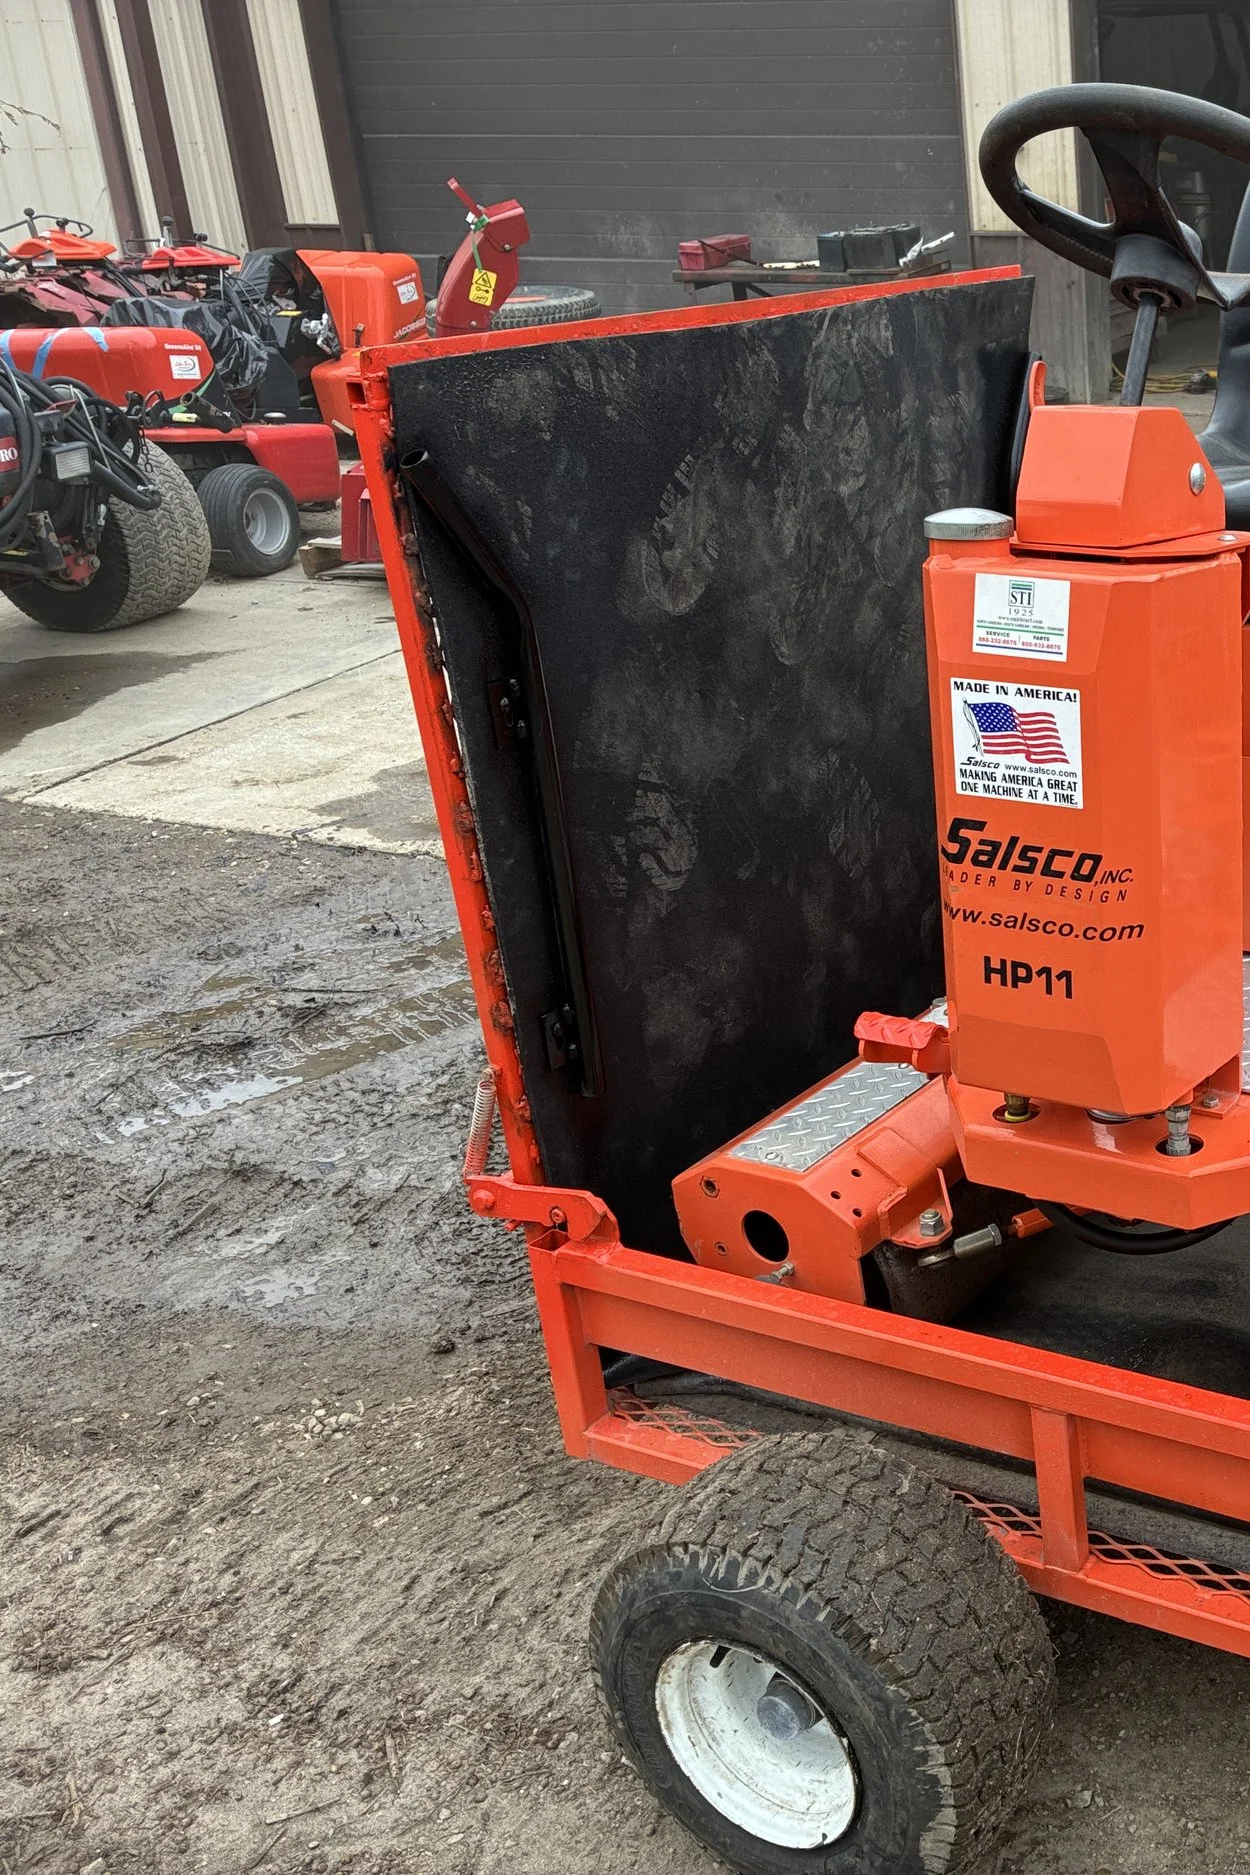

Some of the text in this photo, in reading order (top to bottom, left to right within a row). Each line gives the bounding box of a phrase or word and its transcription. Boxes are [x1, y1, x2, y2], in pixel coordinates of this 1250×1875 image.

[0, 447, 18, 462] RO
[1010, 590, 1032, 606] STI
[1008, 608, 1034, 617] 1925
[953, 681, 1077, 703] MADE IN AMERICA!
[960, 757, 1077, 778] Salsco www.salsco.com
[960, 768, 1077, 792] MAKING AMERICA GREAT
[961, 781, 1078, 805] ONE MACHINE AT A TIME.
[1013, 879, 1034, 893] BY
[1045, 884, 1128, 903] DESIGN
[984, 955, 1073, 1000] HP11
